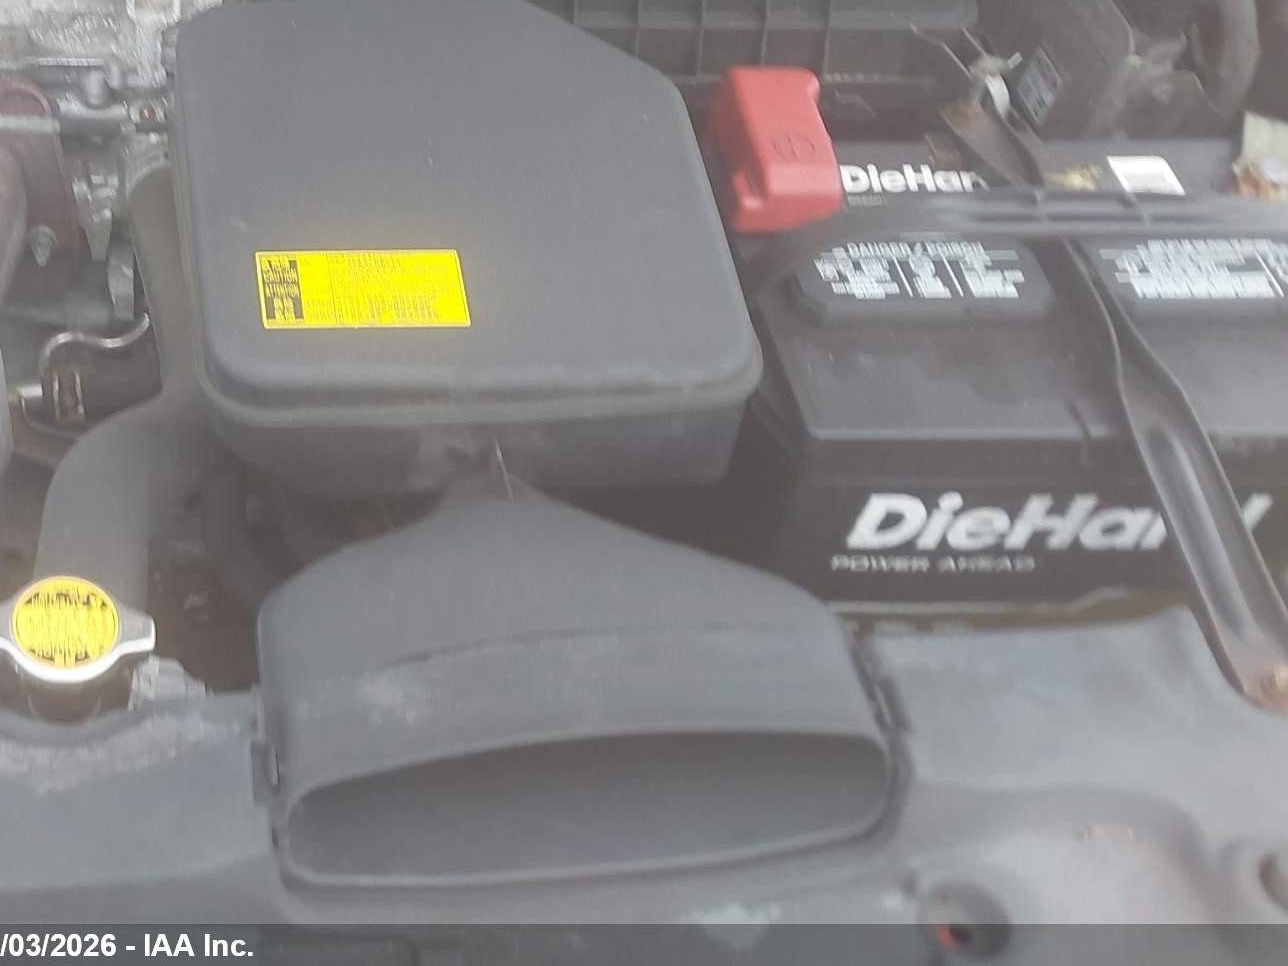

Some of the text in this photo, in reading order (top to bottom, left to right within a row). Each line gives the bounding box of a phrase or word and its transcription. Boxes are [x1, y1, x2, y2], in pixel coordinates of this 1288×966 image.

[839, 163, 991, 194] DieHar
[845, 491, 1273, 551] DieHar
[831, 554, 931, 573] POWER
